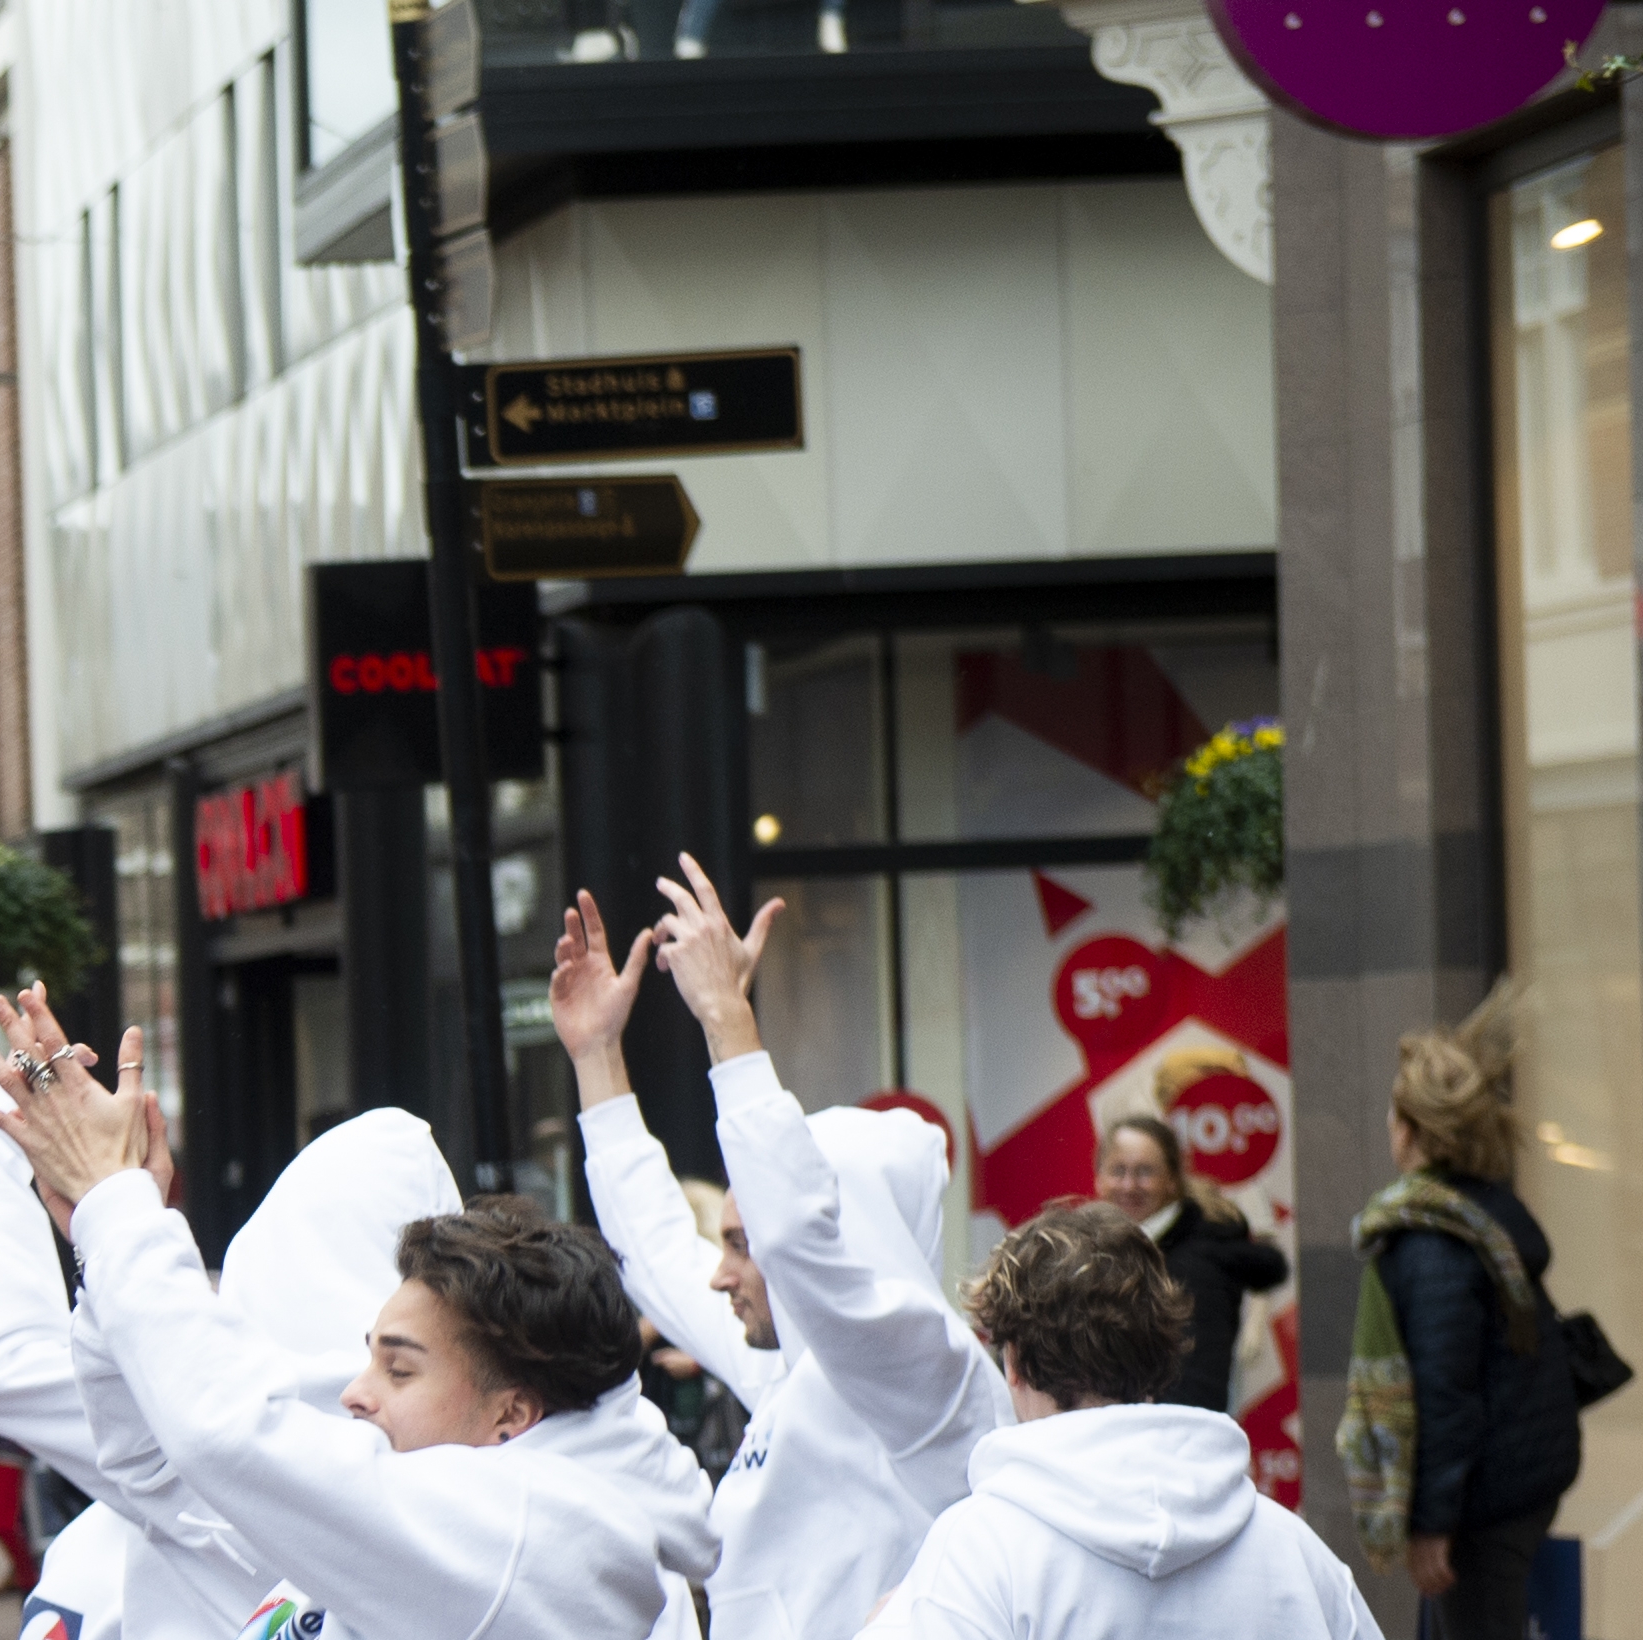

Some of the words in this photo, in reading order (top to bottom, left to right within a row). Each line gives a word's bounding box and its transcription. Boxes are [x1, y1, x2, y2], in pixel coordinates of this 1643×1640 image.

[544, 371, 661, 398] Stadhuis
[545, 397, 687, 423] Marktplein
[329, 648, 527, 694] COOLAT
